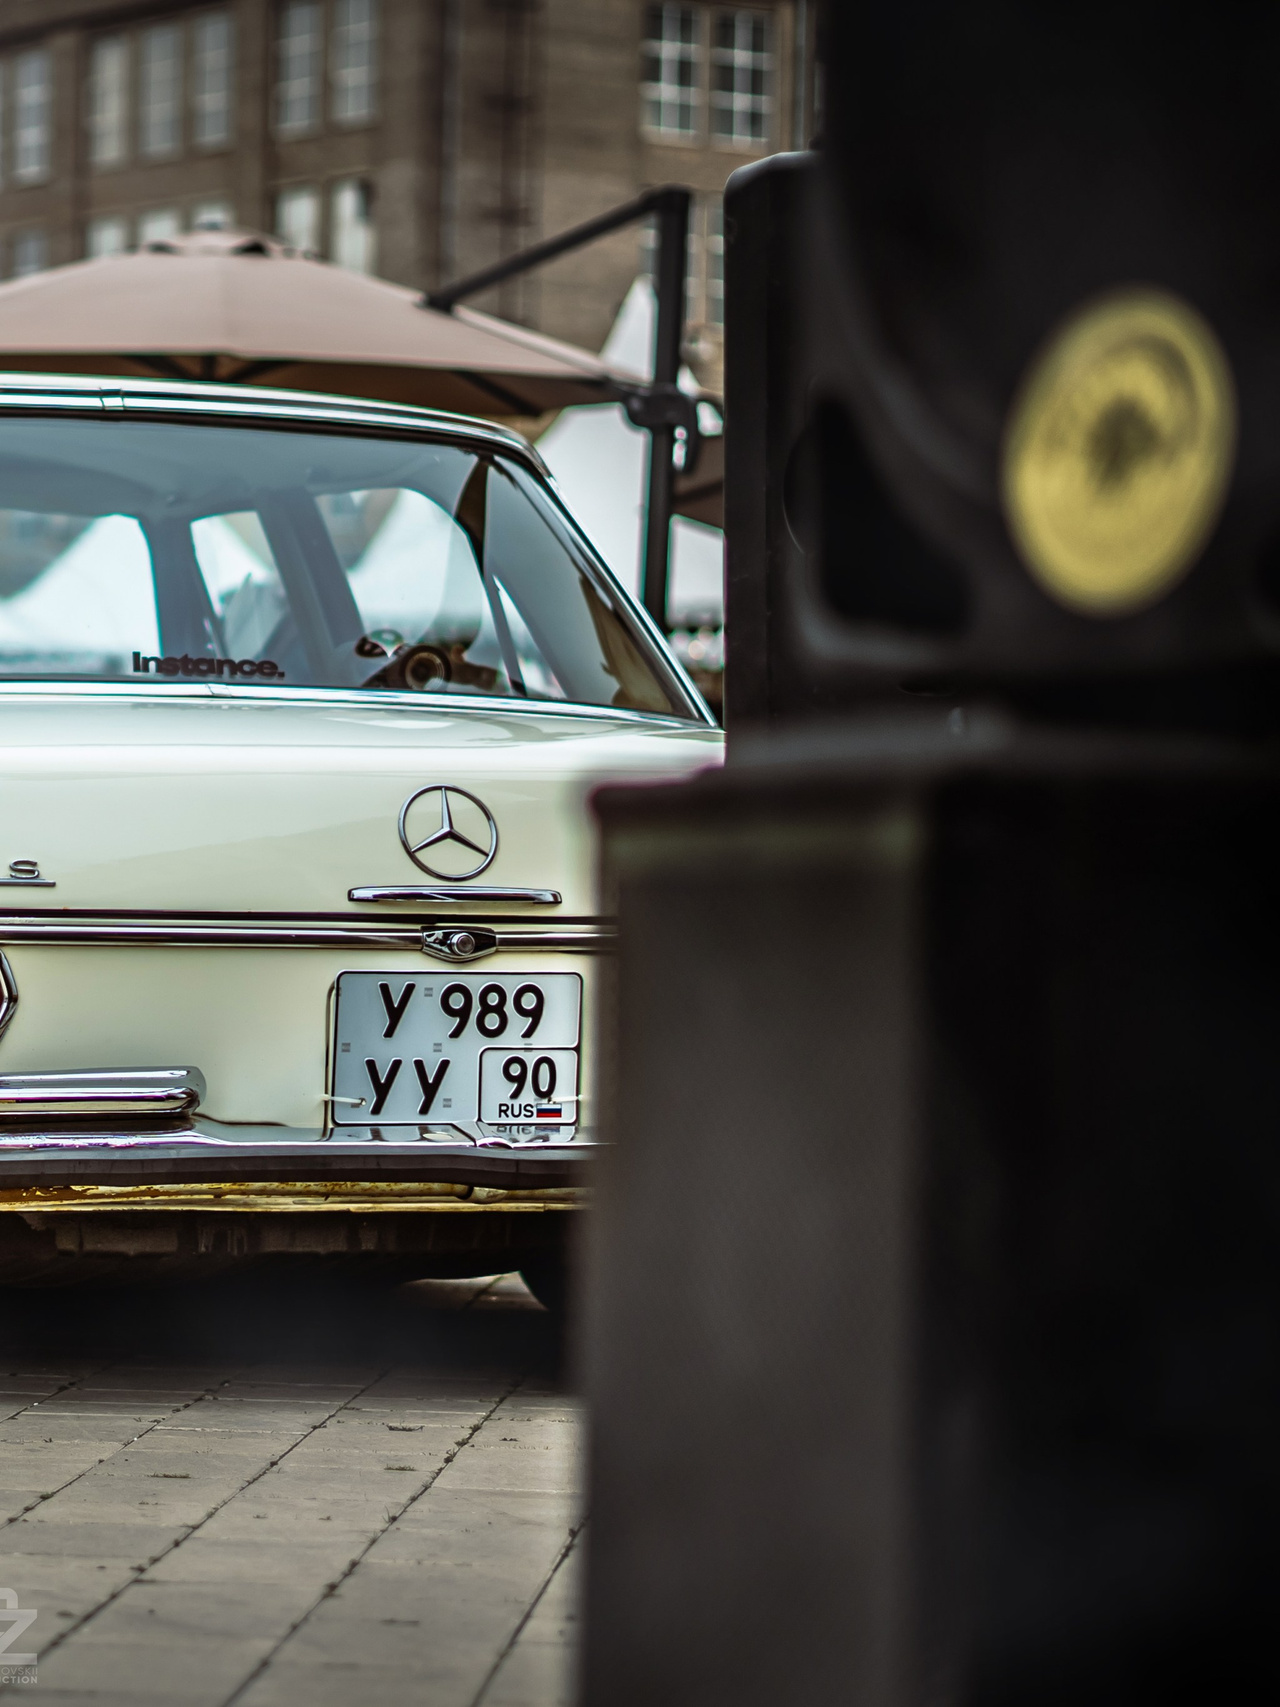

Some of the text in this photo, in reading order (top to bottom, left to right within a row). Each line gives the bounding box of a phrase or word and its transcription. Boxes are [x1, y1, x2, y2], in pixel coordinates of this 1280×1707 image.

[132, 651, 285, 678] Instance.
[9, 859, 40, 879] S
[439, 982, 545, 1039] 989
[502, 1055, 557, 1099] 90
[498, 1103, 534, 1118] RUS
